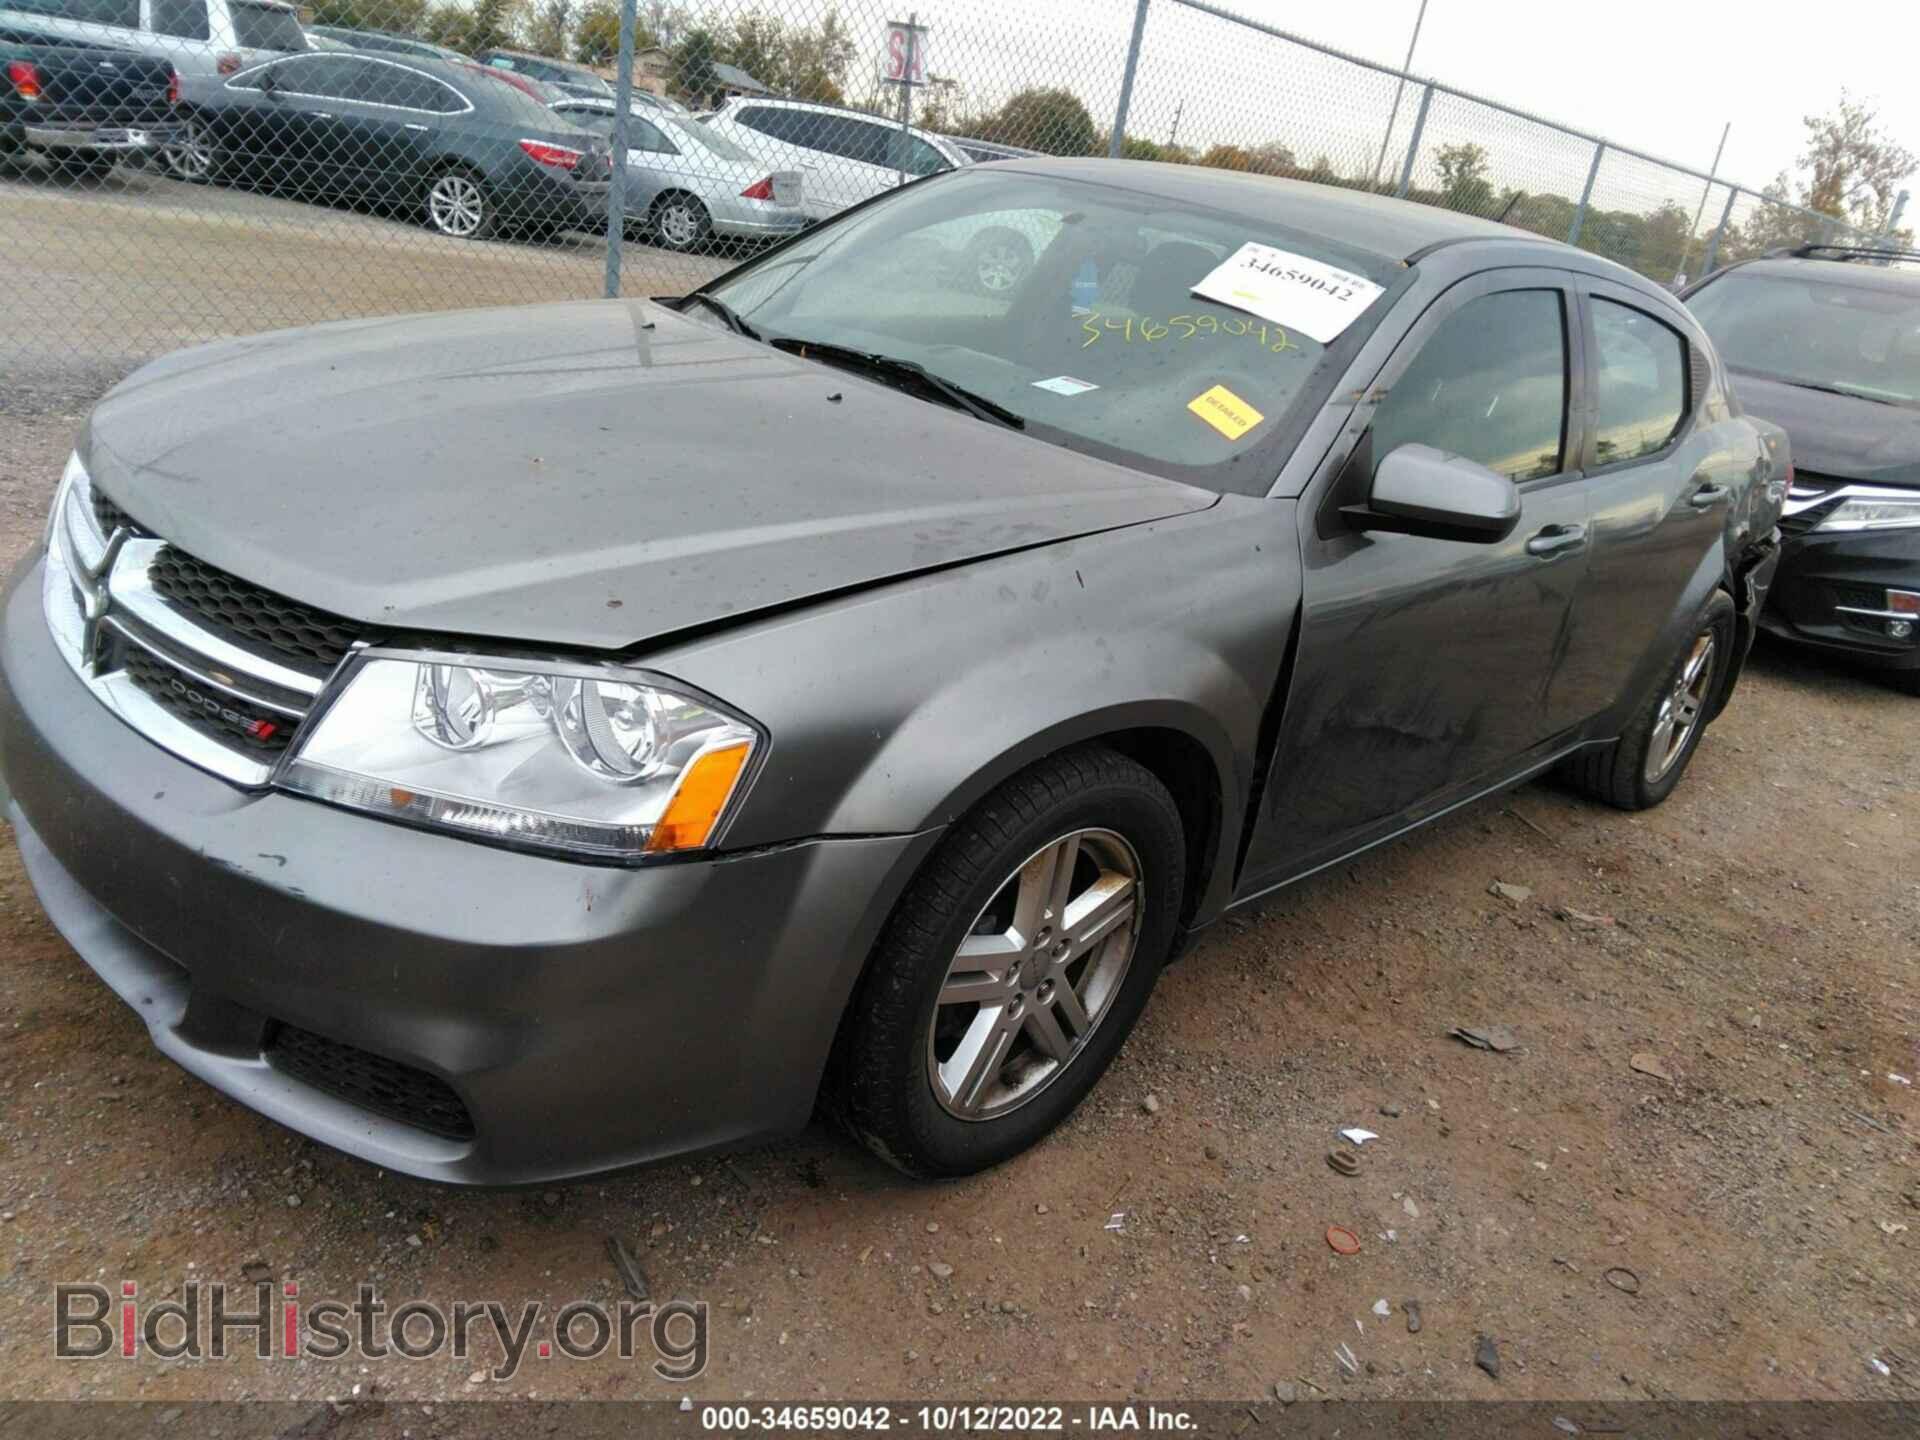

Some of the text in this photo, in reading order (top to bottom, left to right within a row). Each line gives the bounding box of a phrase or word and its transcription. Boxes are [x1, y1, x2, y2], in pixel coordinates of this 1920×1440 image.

[1240, 258, 1353, 301] 34659042
[1071, 312, 1300, 353] 34659042
[170, 678, 259, 733] DODGE
